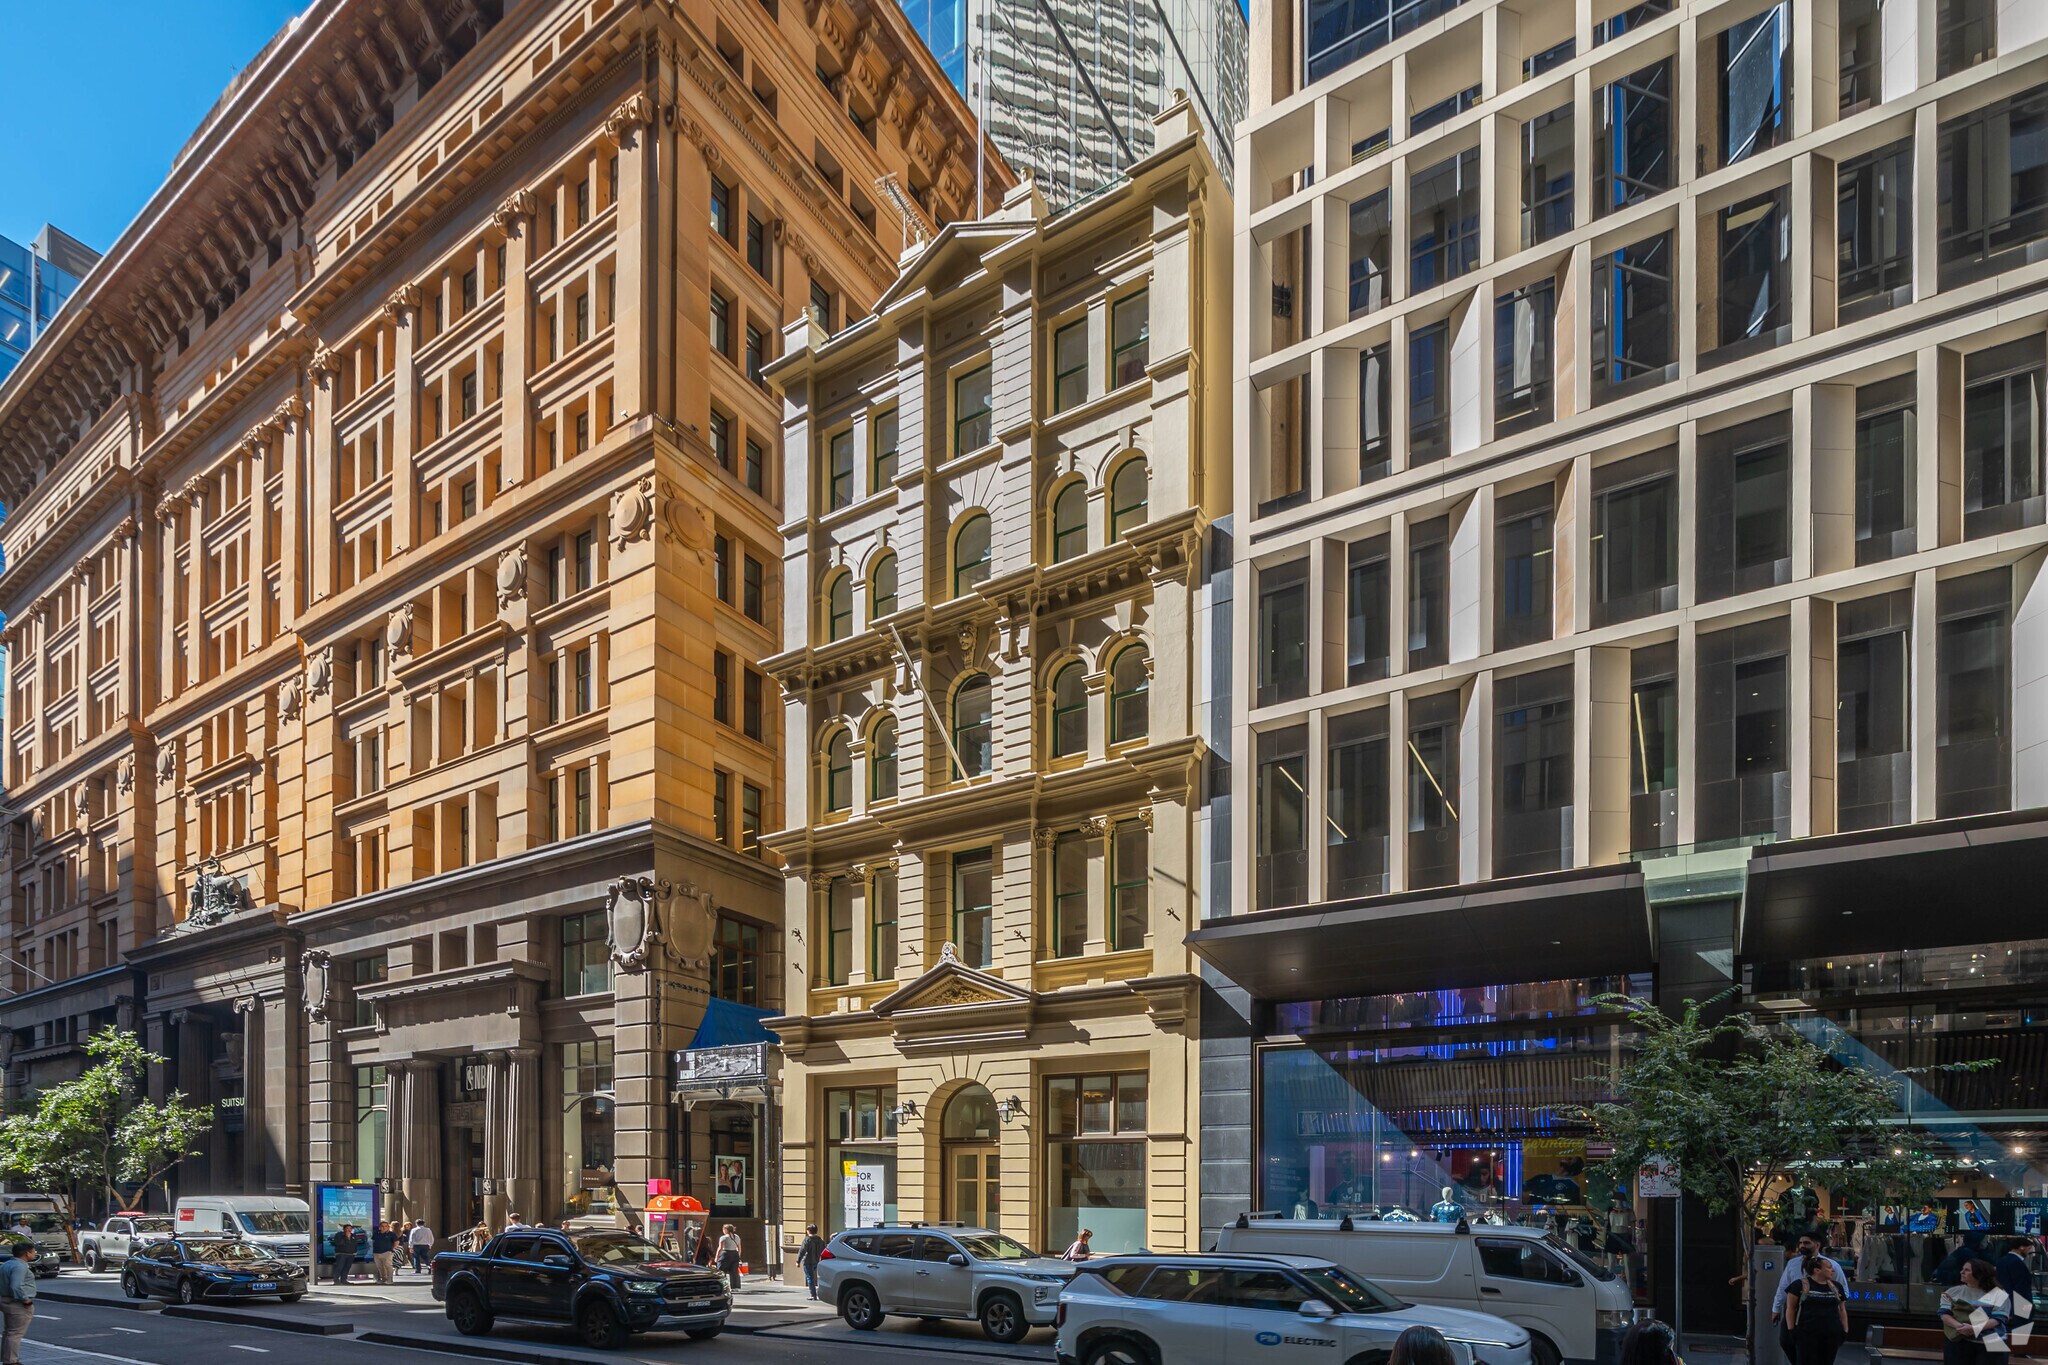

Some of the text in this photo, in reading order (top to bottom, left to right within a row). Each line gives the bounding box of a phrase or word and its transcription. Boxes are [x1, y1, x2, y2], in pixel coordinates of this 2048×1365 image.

[474, 1065, 487, 1090] NB
[221, 1097, 245, 1108] SUITSU
[329, 1205, 368, 1216] RAV4
[1284, 1336, 1337, 1348] ELECTRIC
